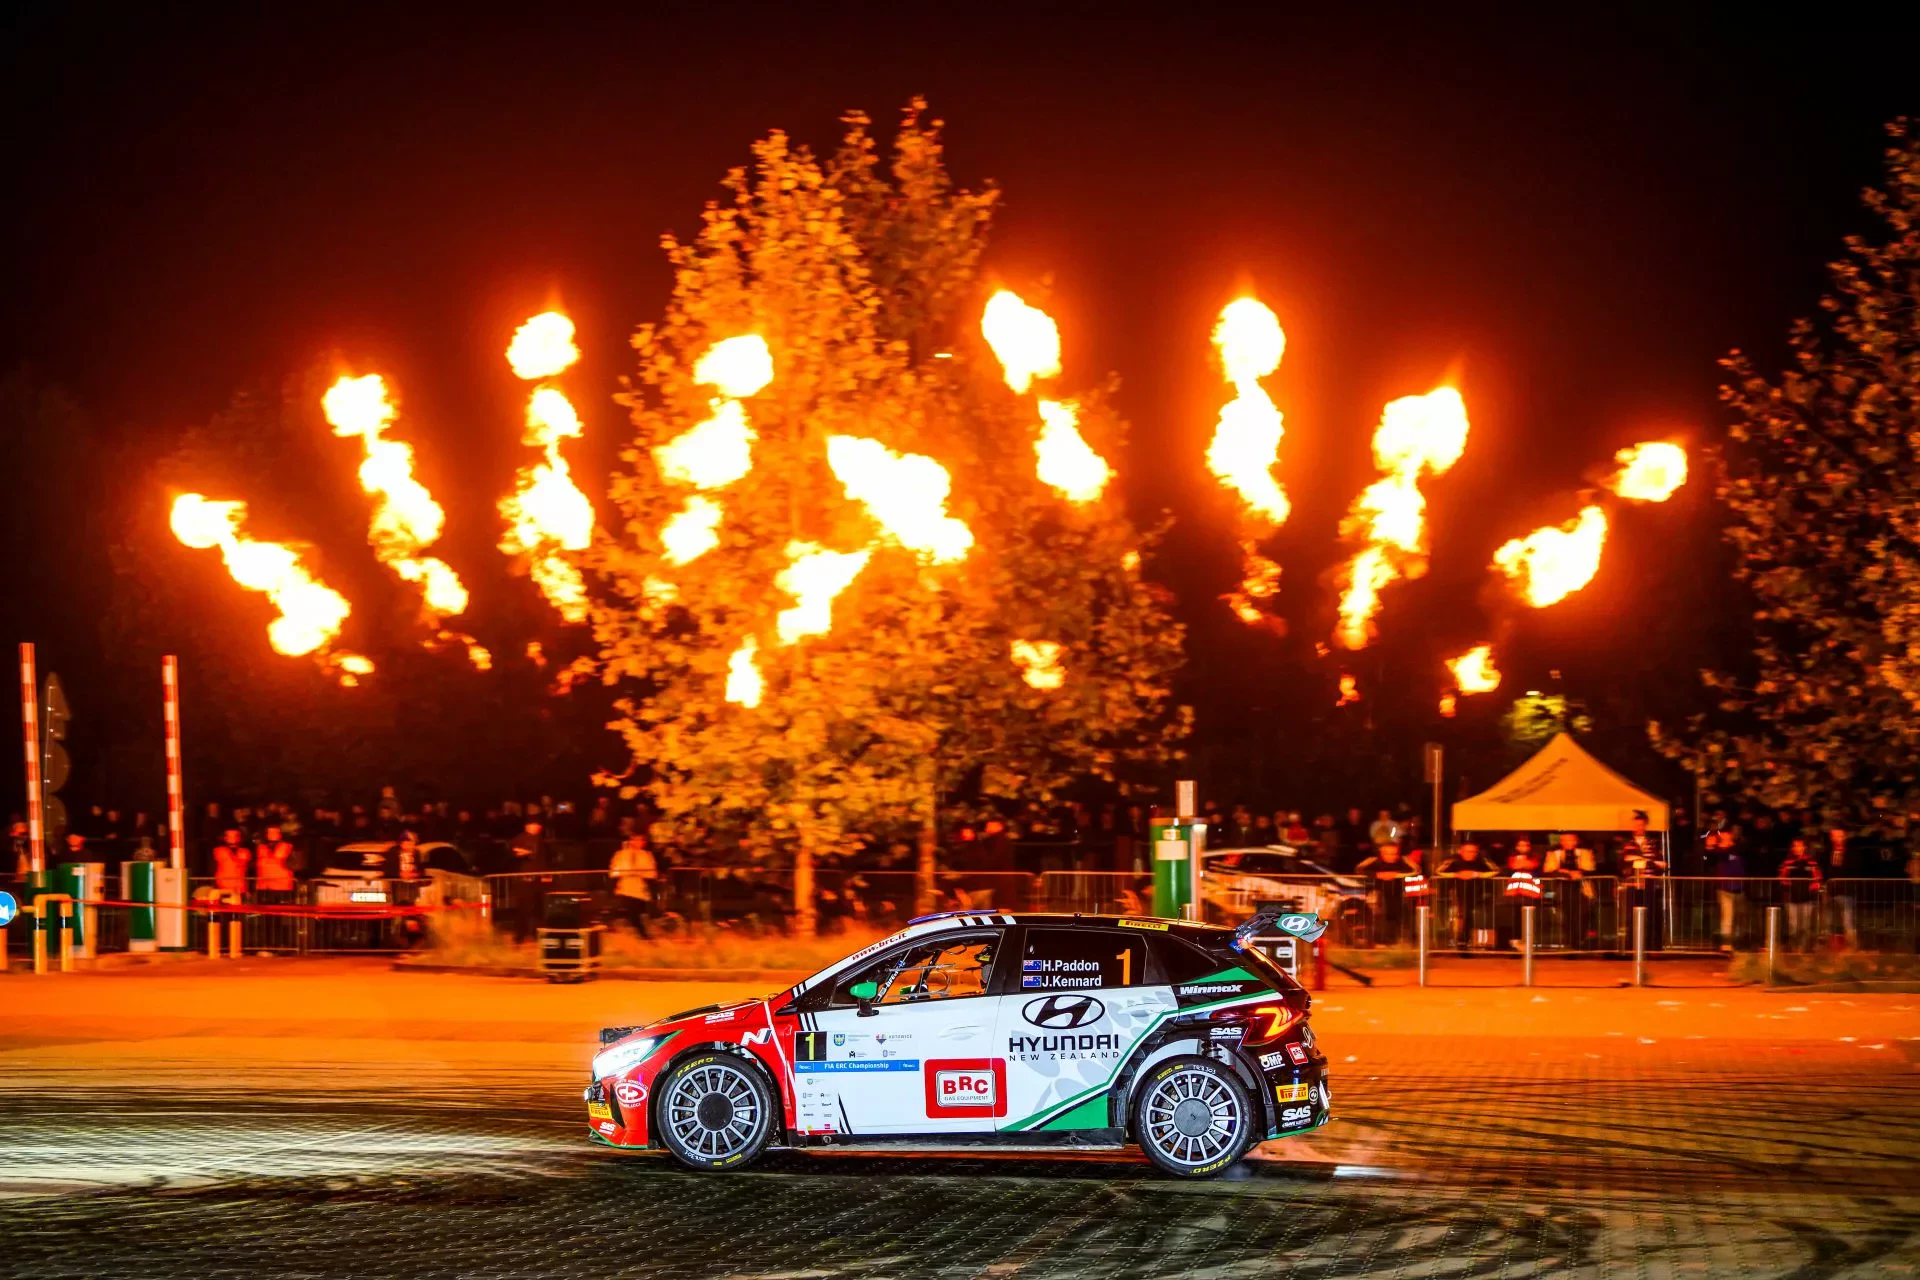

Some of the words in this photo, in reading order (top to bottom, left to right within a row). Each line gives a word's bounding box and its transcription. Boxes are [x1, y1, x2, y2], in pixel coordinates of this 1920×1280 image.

[852, 932, 907, 960] www.brc.it
[1042, 960, 1099, 971] H.Paddon
[1116, 949, 1131, 985] 1
[1042, 975, 1102, 987] J.Kennard
[1180, 985, 1243, 995] Winmax
[1210, 1027, 1242, 1035] SAS
[805, 1032, 815, 1061] 1
[1009, 1034, 1119, 1052] HYUNDAI
[1009, 1053, 1040, 1061] NEW
[1050, 1051, 1119, 1060] ZEALAND
[848, 1061, 889, 1070] Championship
[943, 1076, 988, 1094] BRC
[1280, 1086, 1307, 1099] PIRELLI
[1282, 1105, 1311, 1121] SAS
